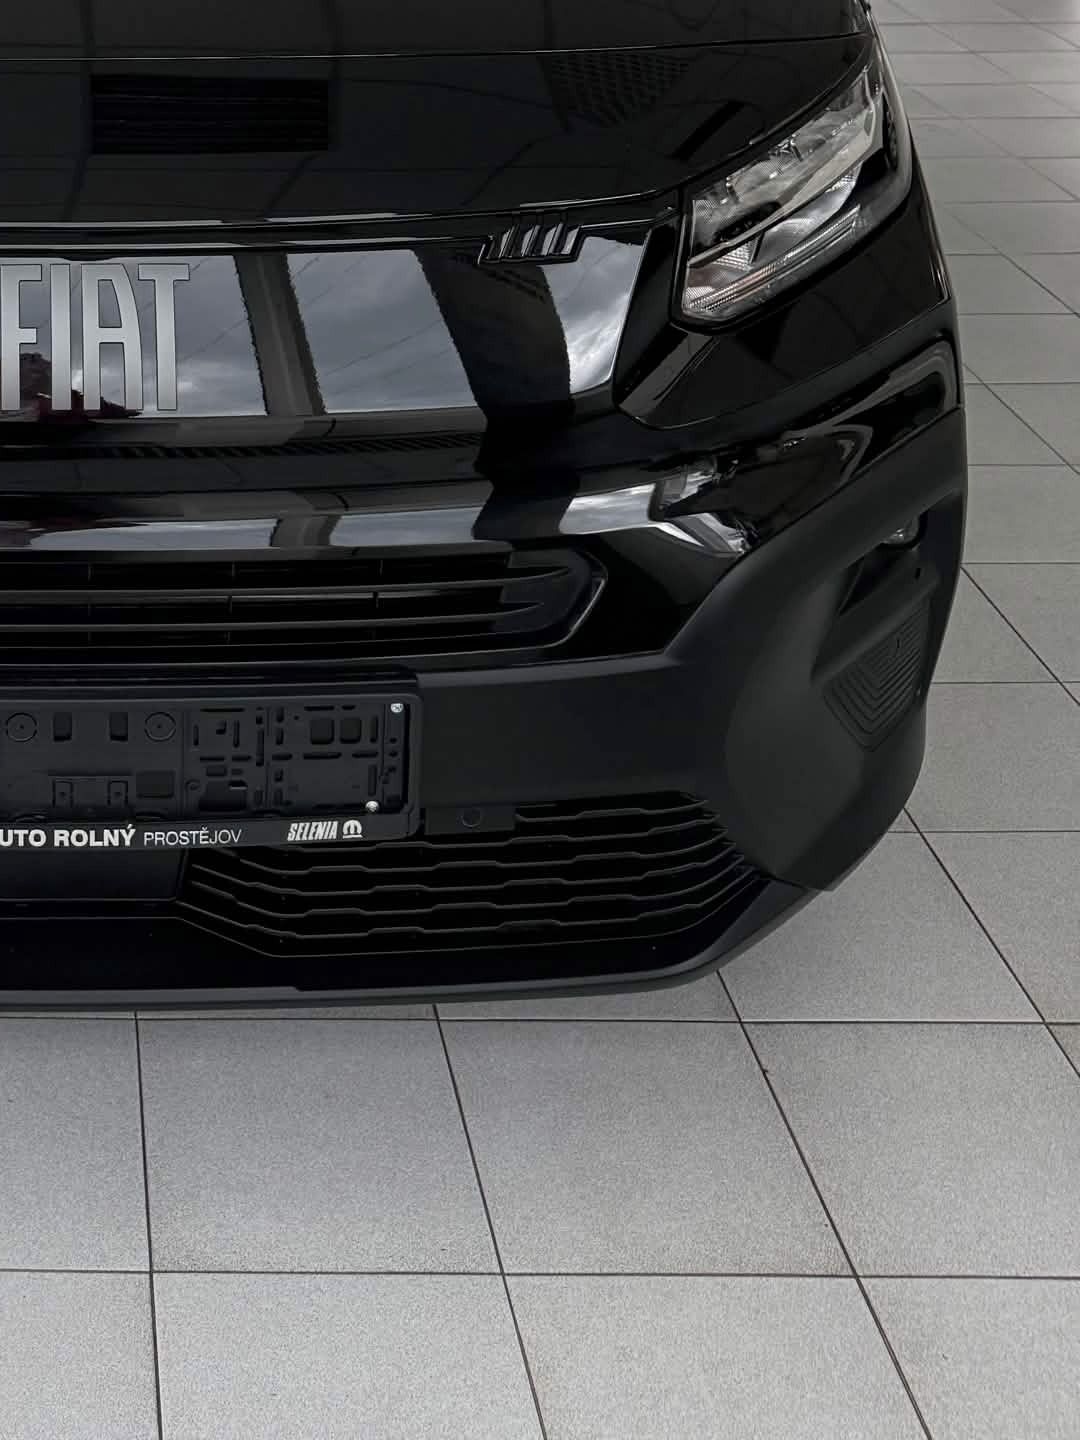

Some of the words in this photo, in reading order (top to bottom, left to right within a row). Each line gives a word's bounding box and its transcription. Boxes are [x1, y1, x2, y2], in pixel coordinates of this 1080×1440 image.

[0, 263, 191, 411] FIAT
[53, 824, 136, 847] ROLNÝ
[143, 826, 242, 846] PROSTĚJOV
[287, 820, 338, 841] SELENIA
